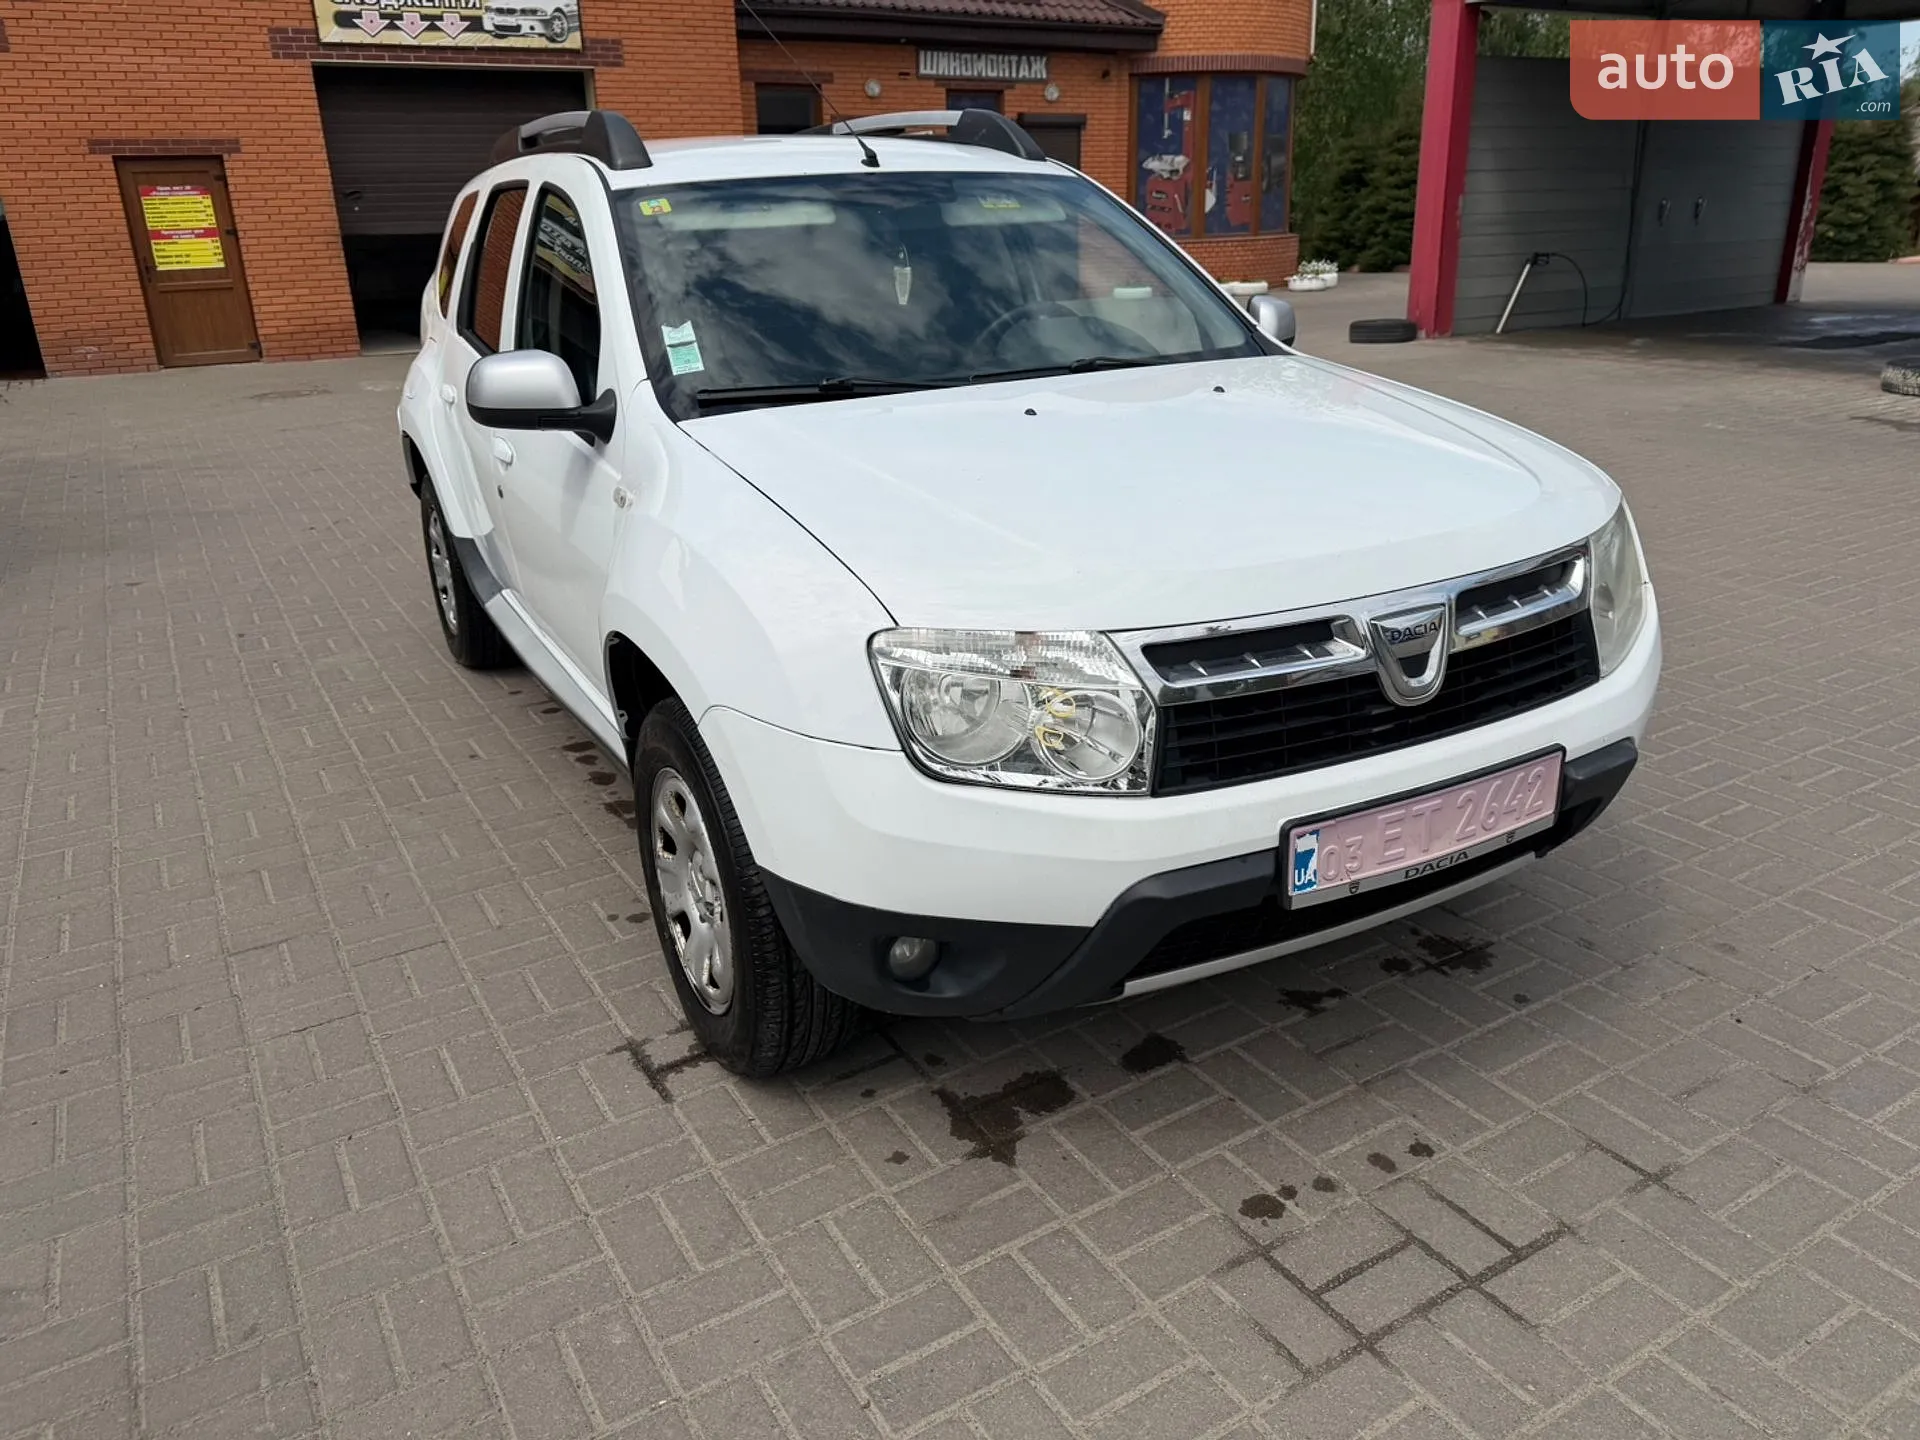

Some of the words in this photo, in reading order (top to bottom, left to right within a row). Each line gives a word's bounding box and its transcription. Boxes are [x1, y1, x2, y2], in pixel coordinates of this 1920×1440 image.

[919, 50, 1047, 79] ШИНОМОНТАЖ
[1390, 621, 1439, 641] DACIA
[1320, 835, 1363, 881] 03
[1377, 799, 1443, 866] ET
[1455, 766, 1546, 843] 2642
[1294, 868, 1318, 887] UA
[1404, 851, 1470, 880] DACIA
